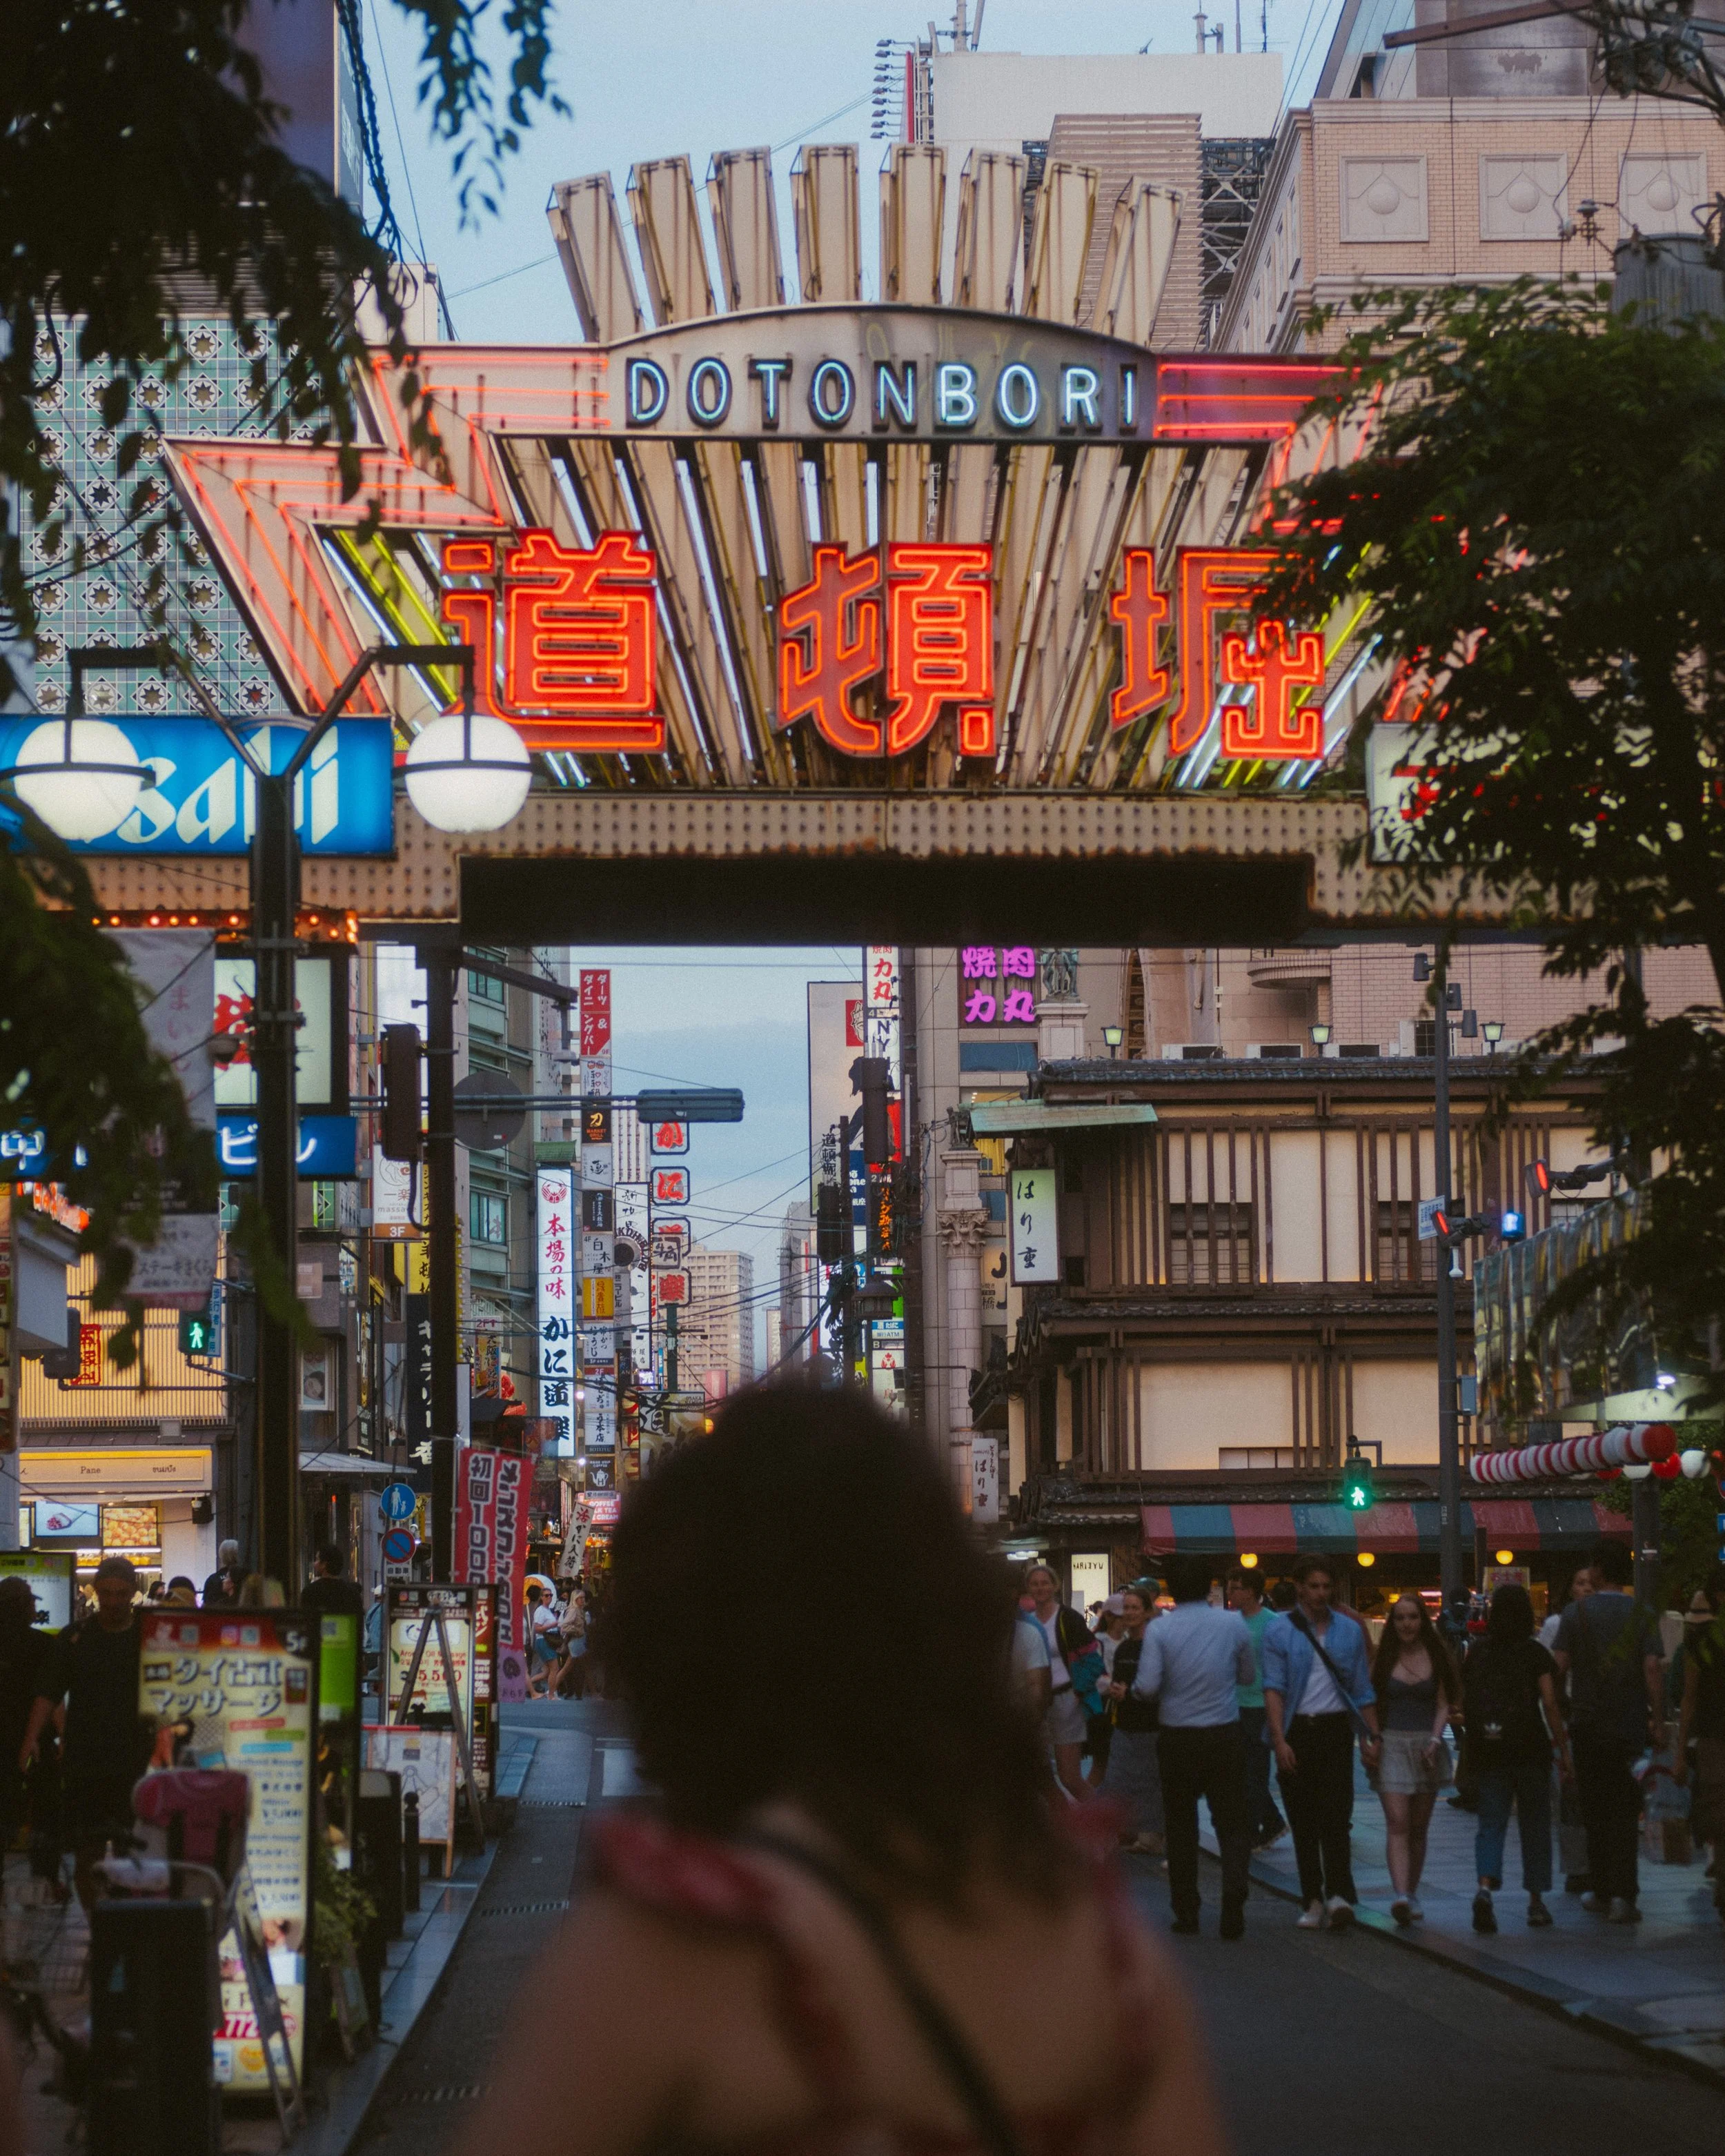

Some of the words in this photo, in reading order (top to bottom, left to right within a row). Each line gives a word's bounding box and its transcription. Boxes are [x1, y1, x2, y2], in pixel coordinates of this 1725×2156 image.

[625, 357, 1138, 432] DOTONBORI
[440, 528, 1325, 760] 道頓堀
[874, 958, 892, 1000] 力丸
[962, 946, 1035, 978] 焼肉
[965, 989, 1035, 1022] 力丸
[390, 1226, 406, 1237] 3F
[656, 1122, 685, 1302] かに楽
[1017, 1180, 1038, 1268] はり重
[544, 1213, 566, 1300] 本場の味
[593, 1238, 611, 1275] 白木屋
[543, 1315, 569, 1441] かに道楽
[81, 1466, 101, 1474] Pane
[974, 1459, 988, 1507] はり重
